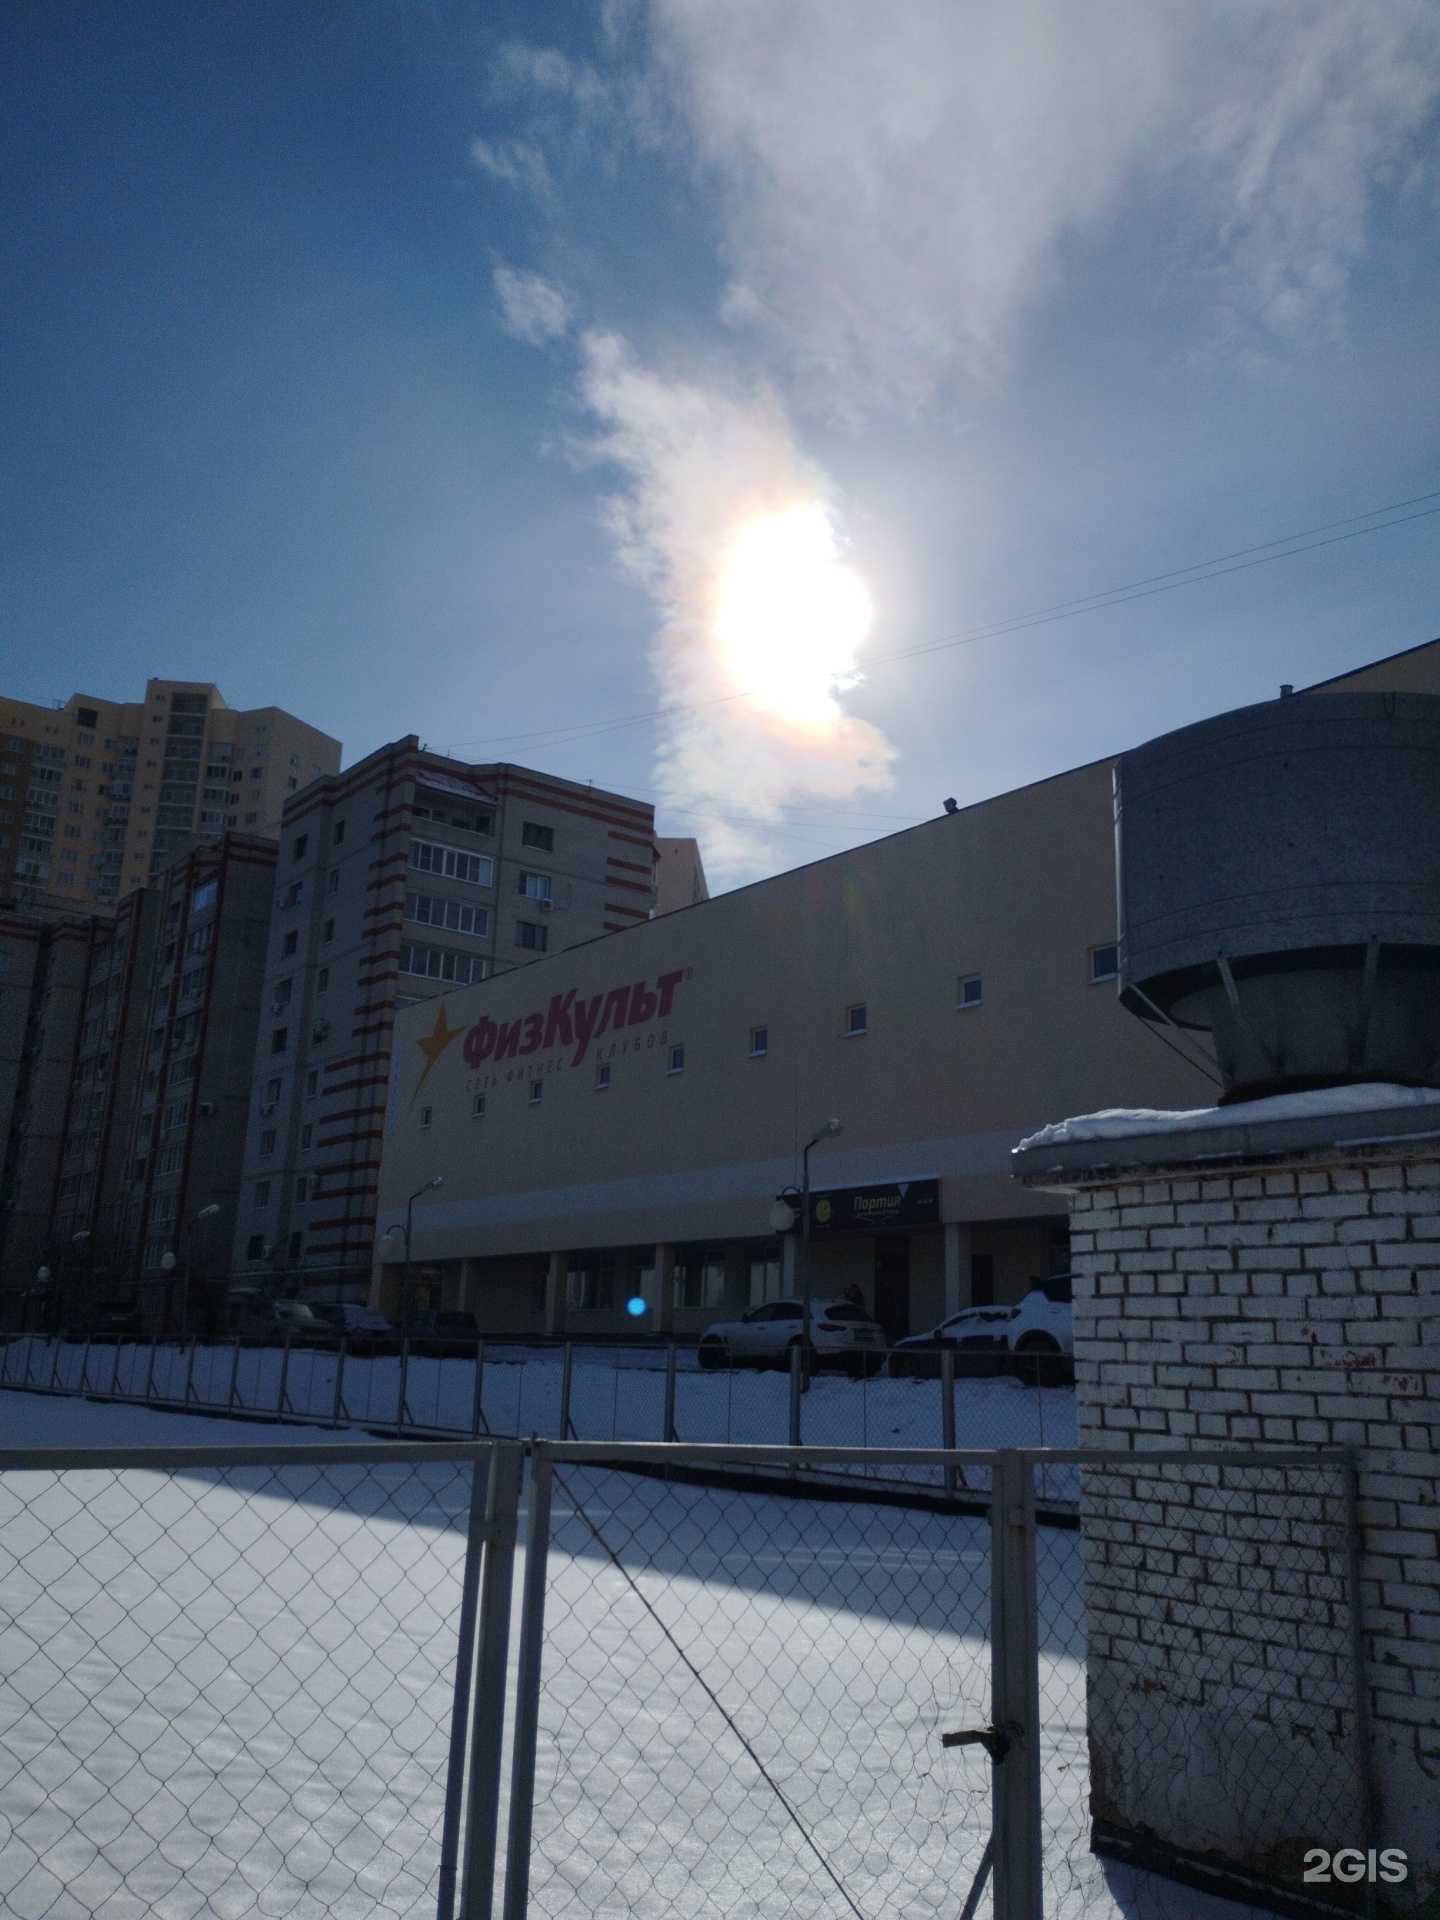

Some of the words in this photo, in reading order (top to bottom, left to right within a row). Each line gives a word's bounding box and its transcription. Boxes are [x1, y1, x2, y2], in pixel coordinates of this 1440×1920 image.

[463, 968, 684, 1069] ФизКульт
[506, 1057, 564, 1083] ФИТНЕС
[596, 1030, 671, 1059] КЛУБОВ
